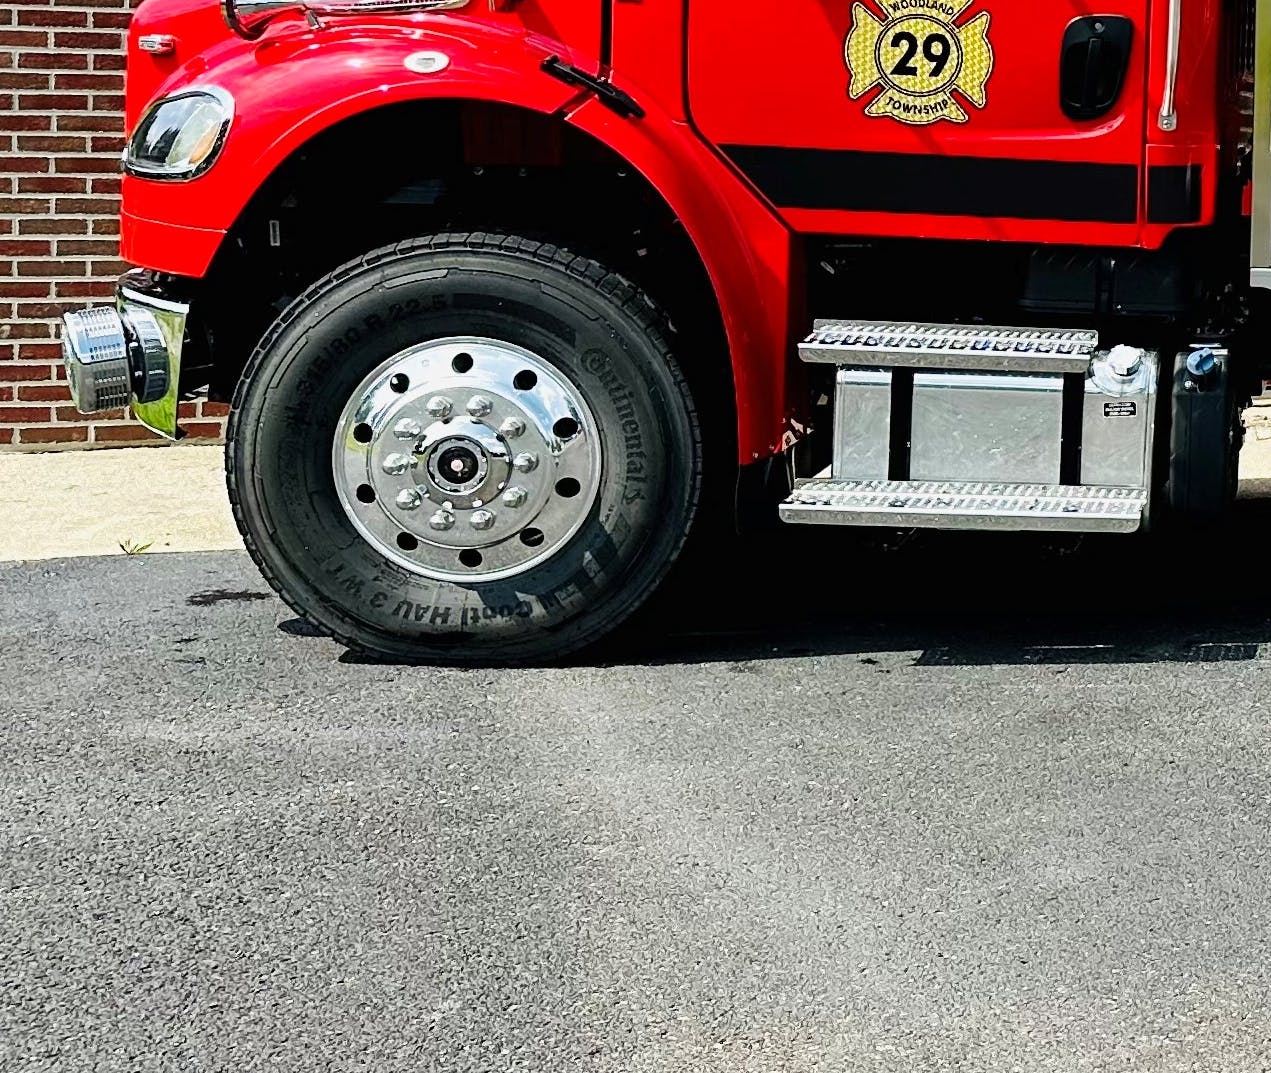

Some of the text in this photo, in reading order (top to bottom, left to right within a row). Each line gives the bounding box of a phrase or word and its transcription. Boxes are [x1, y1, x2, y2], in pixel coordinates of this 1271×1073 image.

[889, 31, 951, 77] 29
[885, 96, 949, 115] TOWNSHIP
[389, 294, 448, 316] 22.5
[580, 347, 648, 483] Continental
[369, 591, 389, 609] 3
[393, 599, 452, 626] HAU
